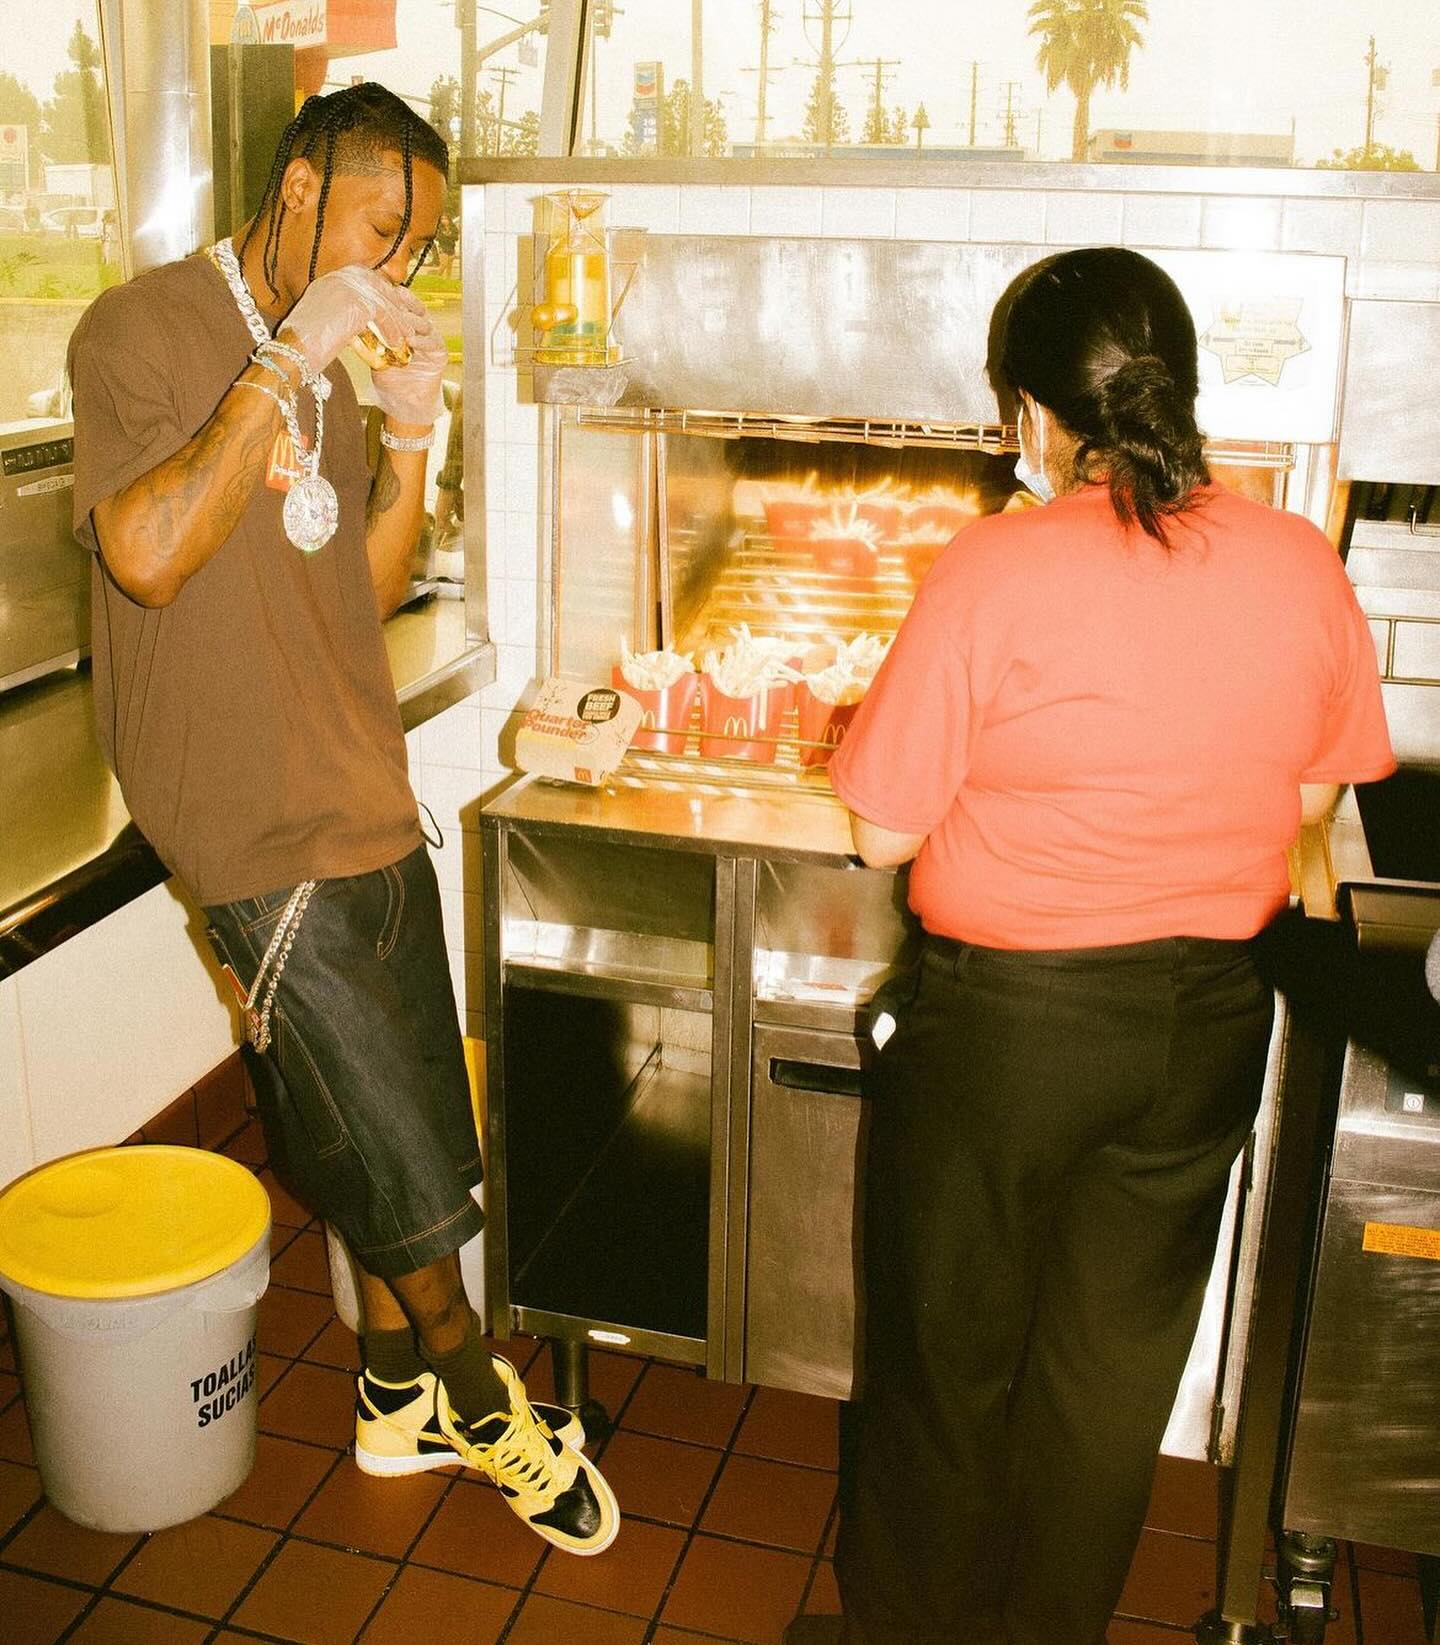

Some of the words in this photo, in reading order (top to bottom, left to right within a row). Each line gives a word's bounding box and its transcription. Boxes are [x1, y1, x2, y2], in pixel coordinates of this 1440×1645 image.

[584, 702, 614, 711] BEEF
[519, 719, 587, 740] Pounder
[525, 709, 590, 731] Quarter
